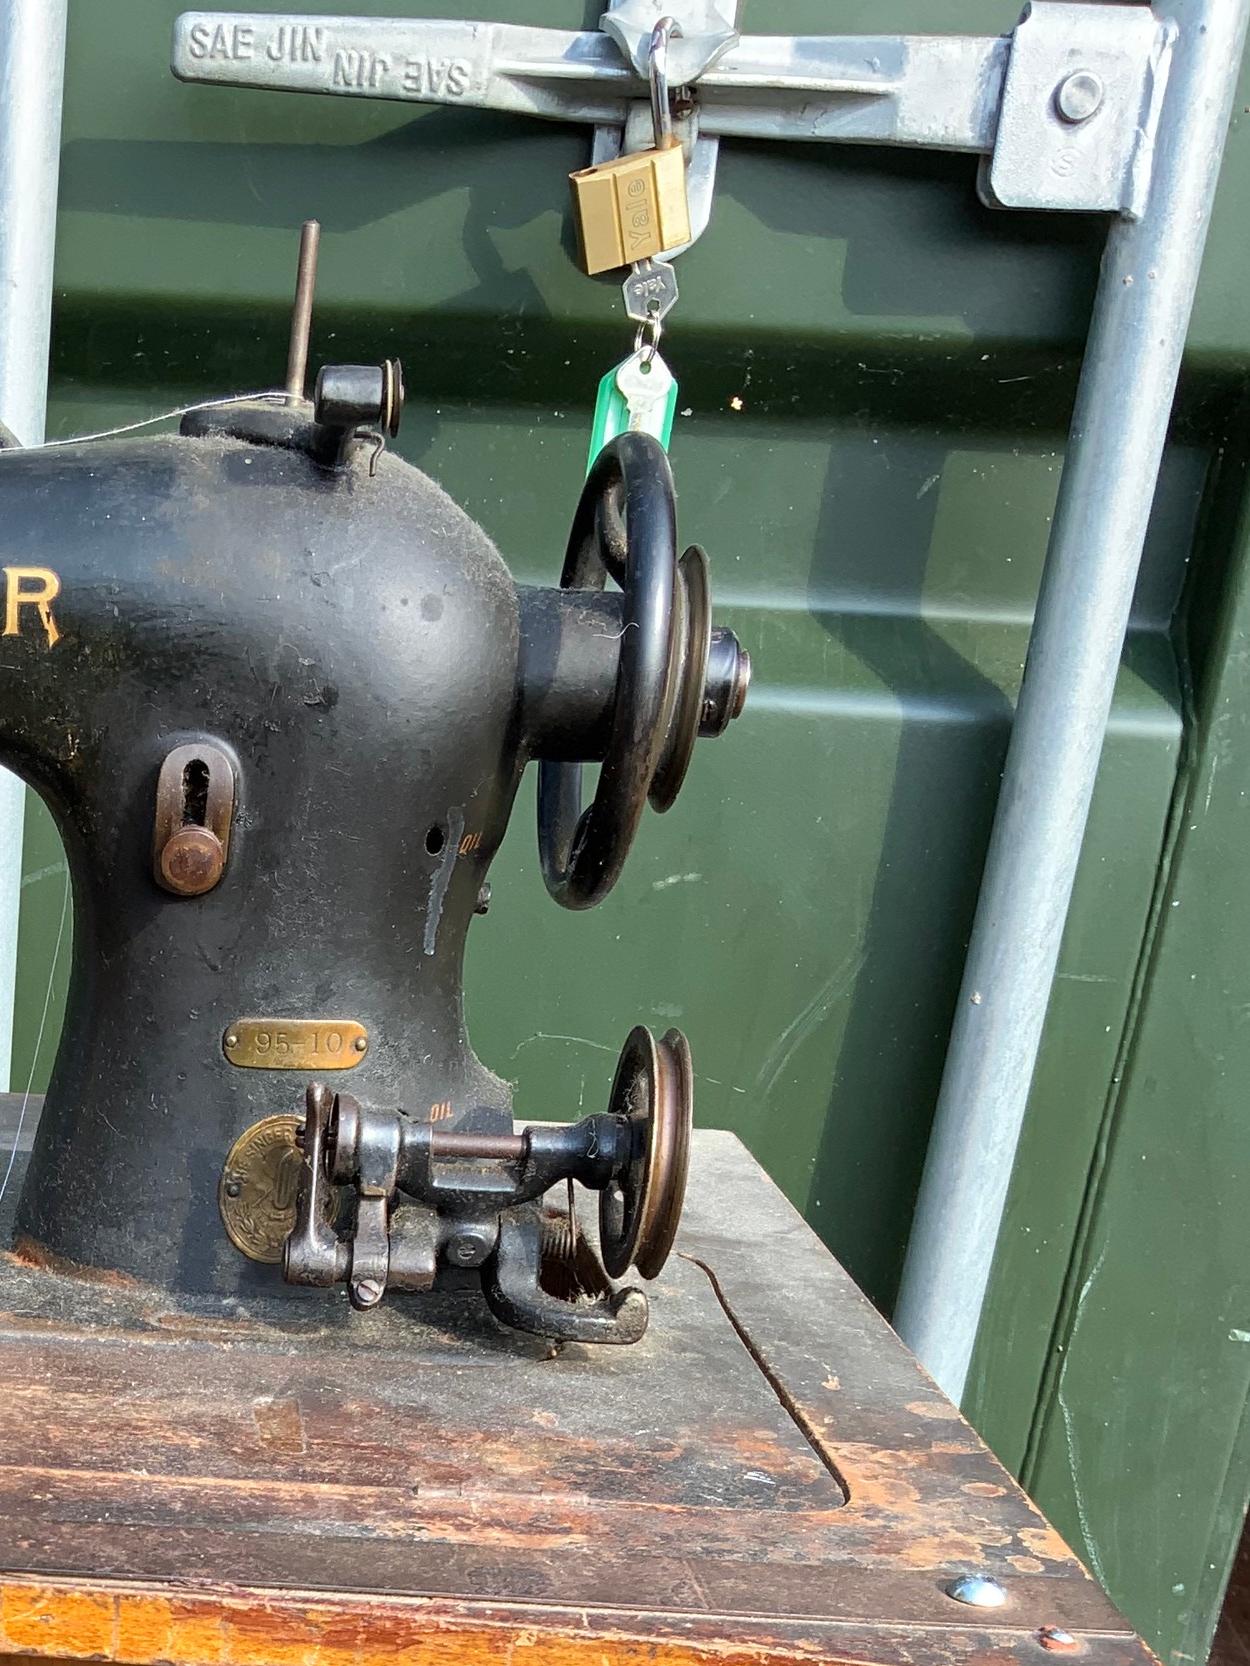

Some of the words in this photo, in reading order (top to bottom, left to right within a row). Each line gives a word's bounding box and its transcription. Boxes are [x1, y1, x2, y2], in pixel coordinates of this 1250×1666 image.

[189, 23, 253, 60] SAE
[266, 25, 325, 62] JIN
[333, 50, 390, 88] JIN
[402, 58, 469, 96] SAE
[626, 178, 651, 251] Yale
[634, 276, 666, 297] Yale
[255, 1031, 343, 1056] 95-10
[430, 1101, 454, 1123] OIL
[245, 1127, 294, 1159] SINGER
